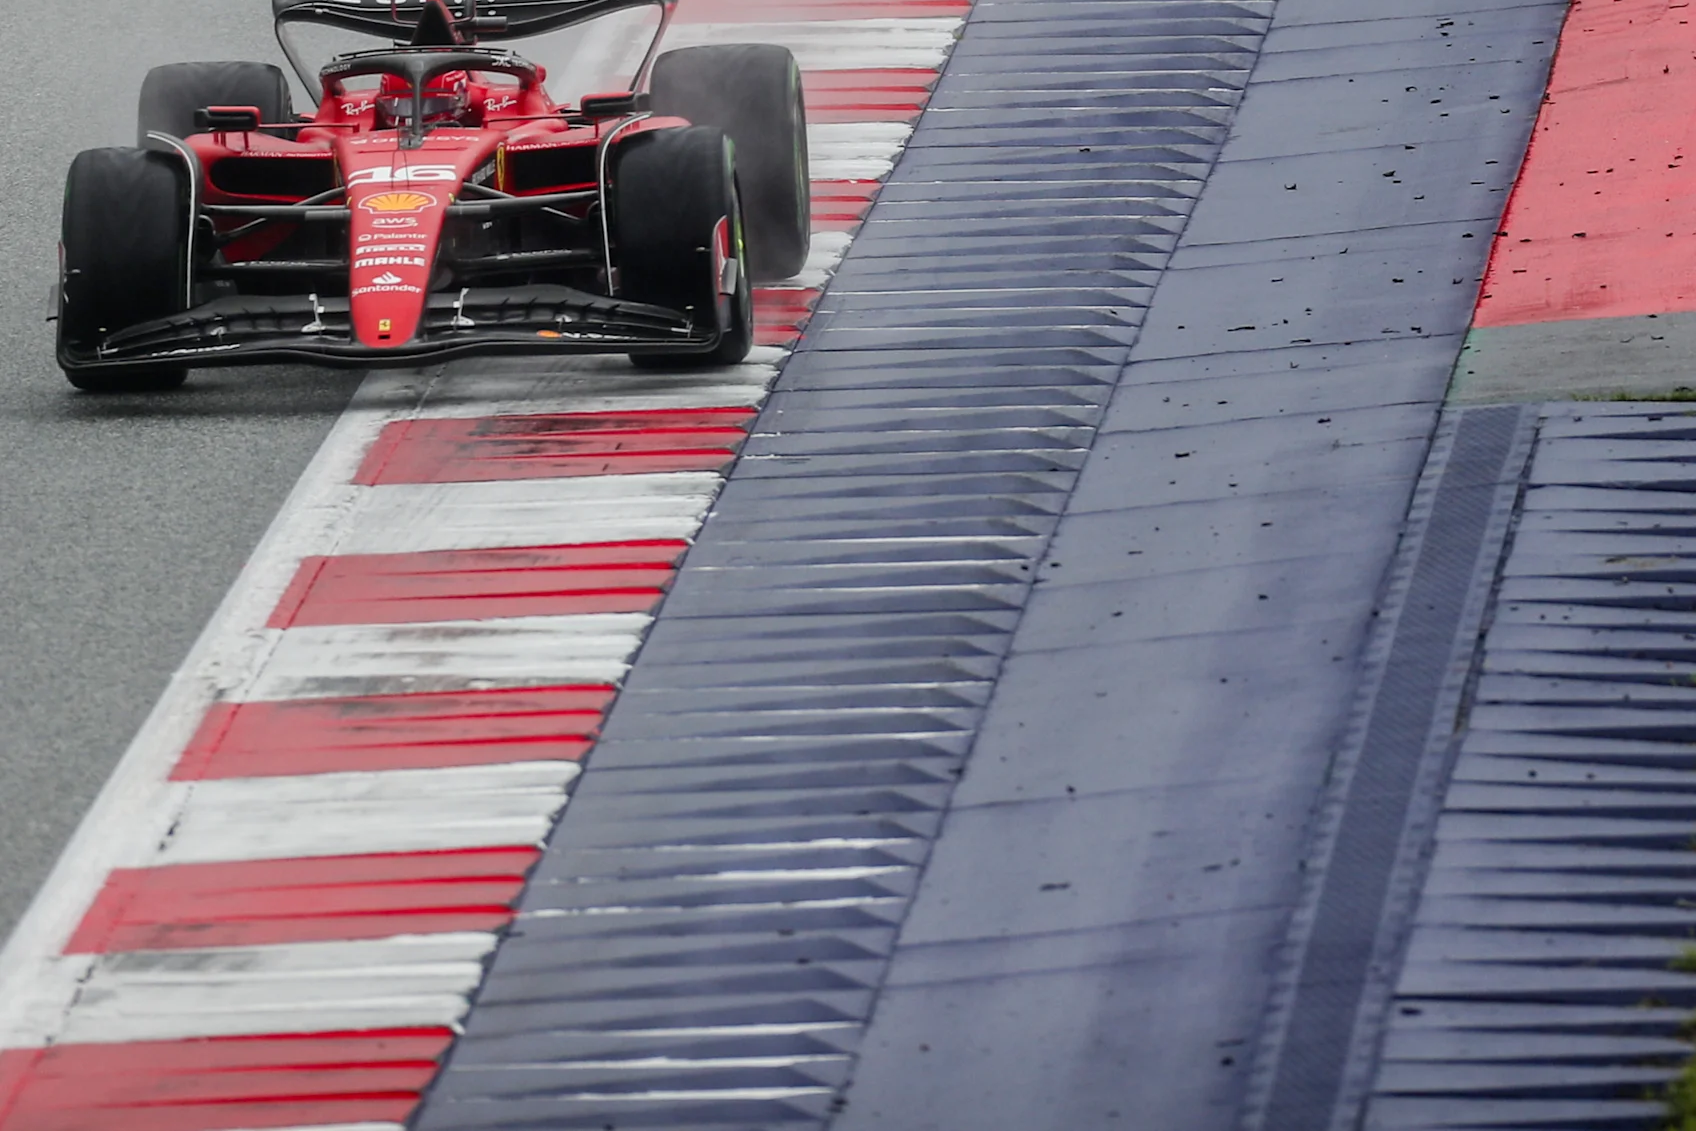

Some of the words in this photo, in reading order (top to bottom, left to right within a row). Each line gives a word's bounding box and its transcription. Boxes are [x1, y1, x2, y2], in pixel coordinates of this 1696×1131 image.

[373, 135, 480, 144] GEESYS
[348, 165, 456, 189] 16
[371, 216, 418, 228] aws
[355, 244, 425, 255] PIRELLI
[354, 256, 425, 268] MAHLE
